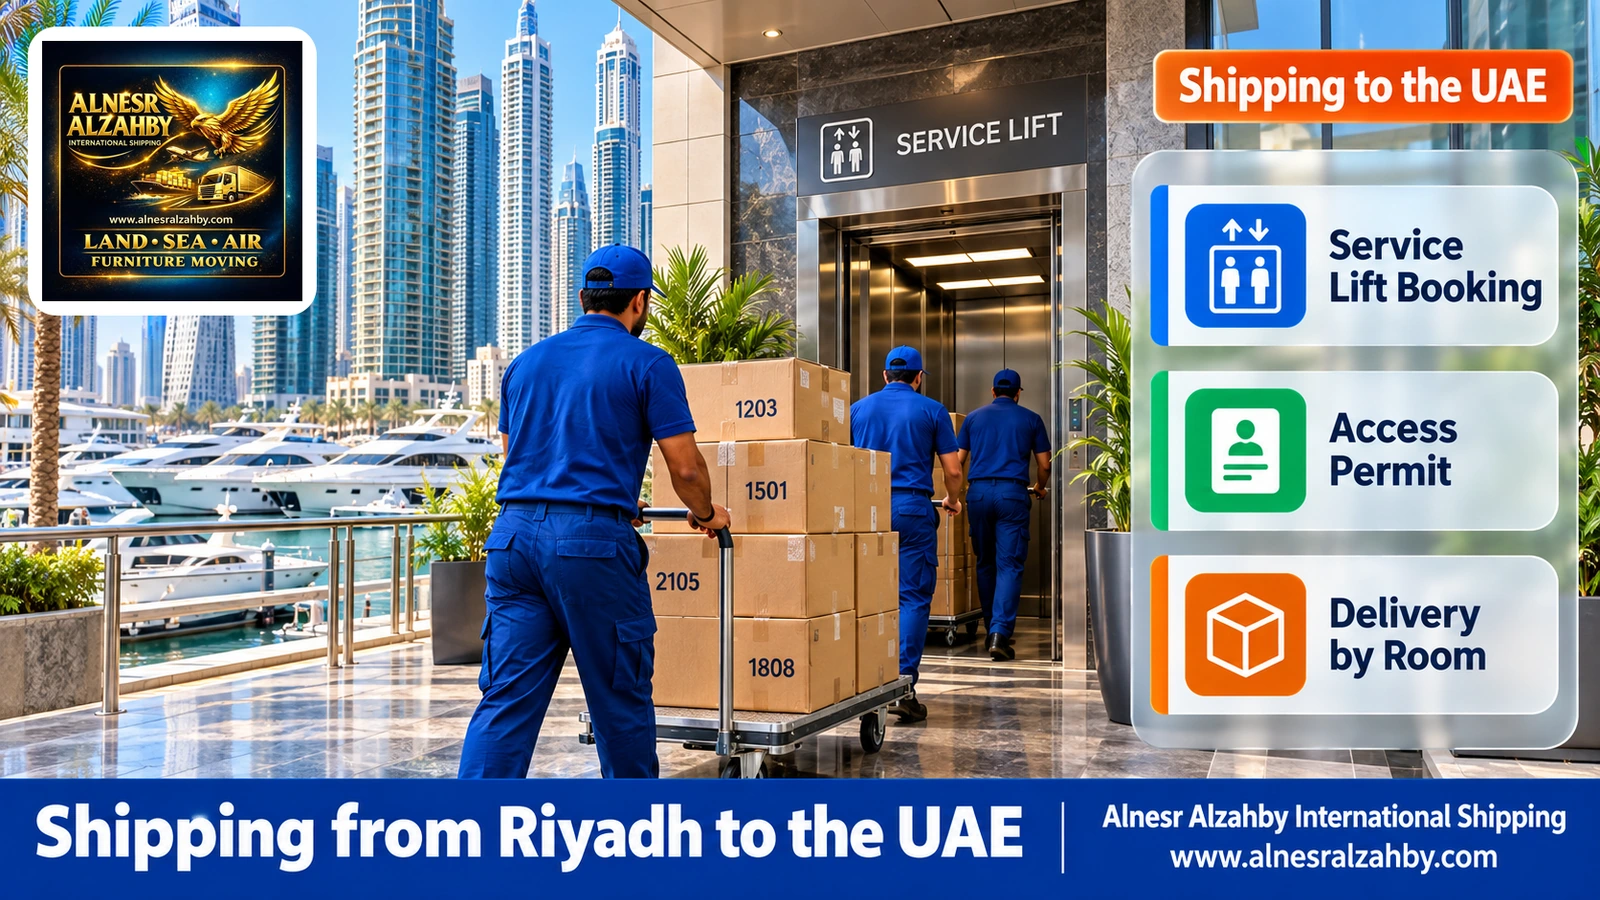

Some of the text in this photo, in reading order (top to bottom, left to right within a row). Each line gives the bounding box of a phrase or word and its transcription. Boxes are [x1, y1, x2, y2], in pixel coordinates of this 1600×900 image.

[896, 111, 1063, 156] SERVICE LIFT
[735, 398, 778, 419] 1203
[745, 480, 788, 501] 1501
[655, 571, 700, 592] 2105
[748, 657, 795, 678] 1808
